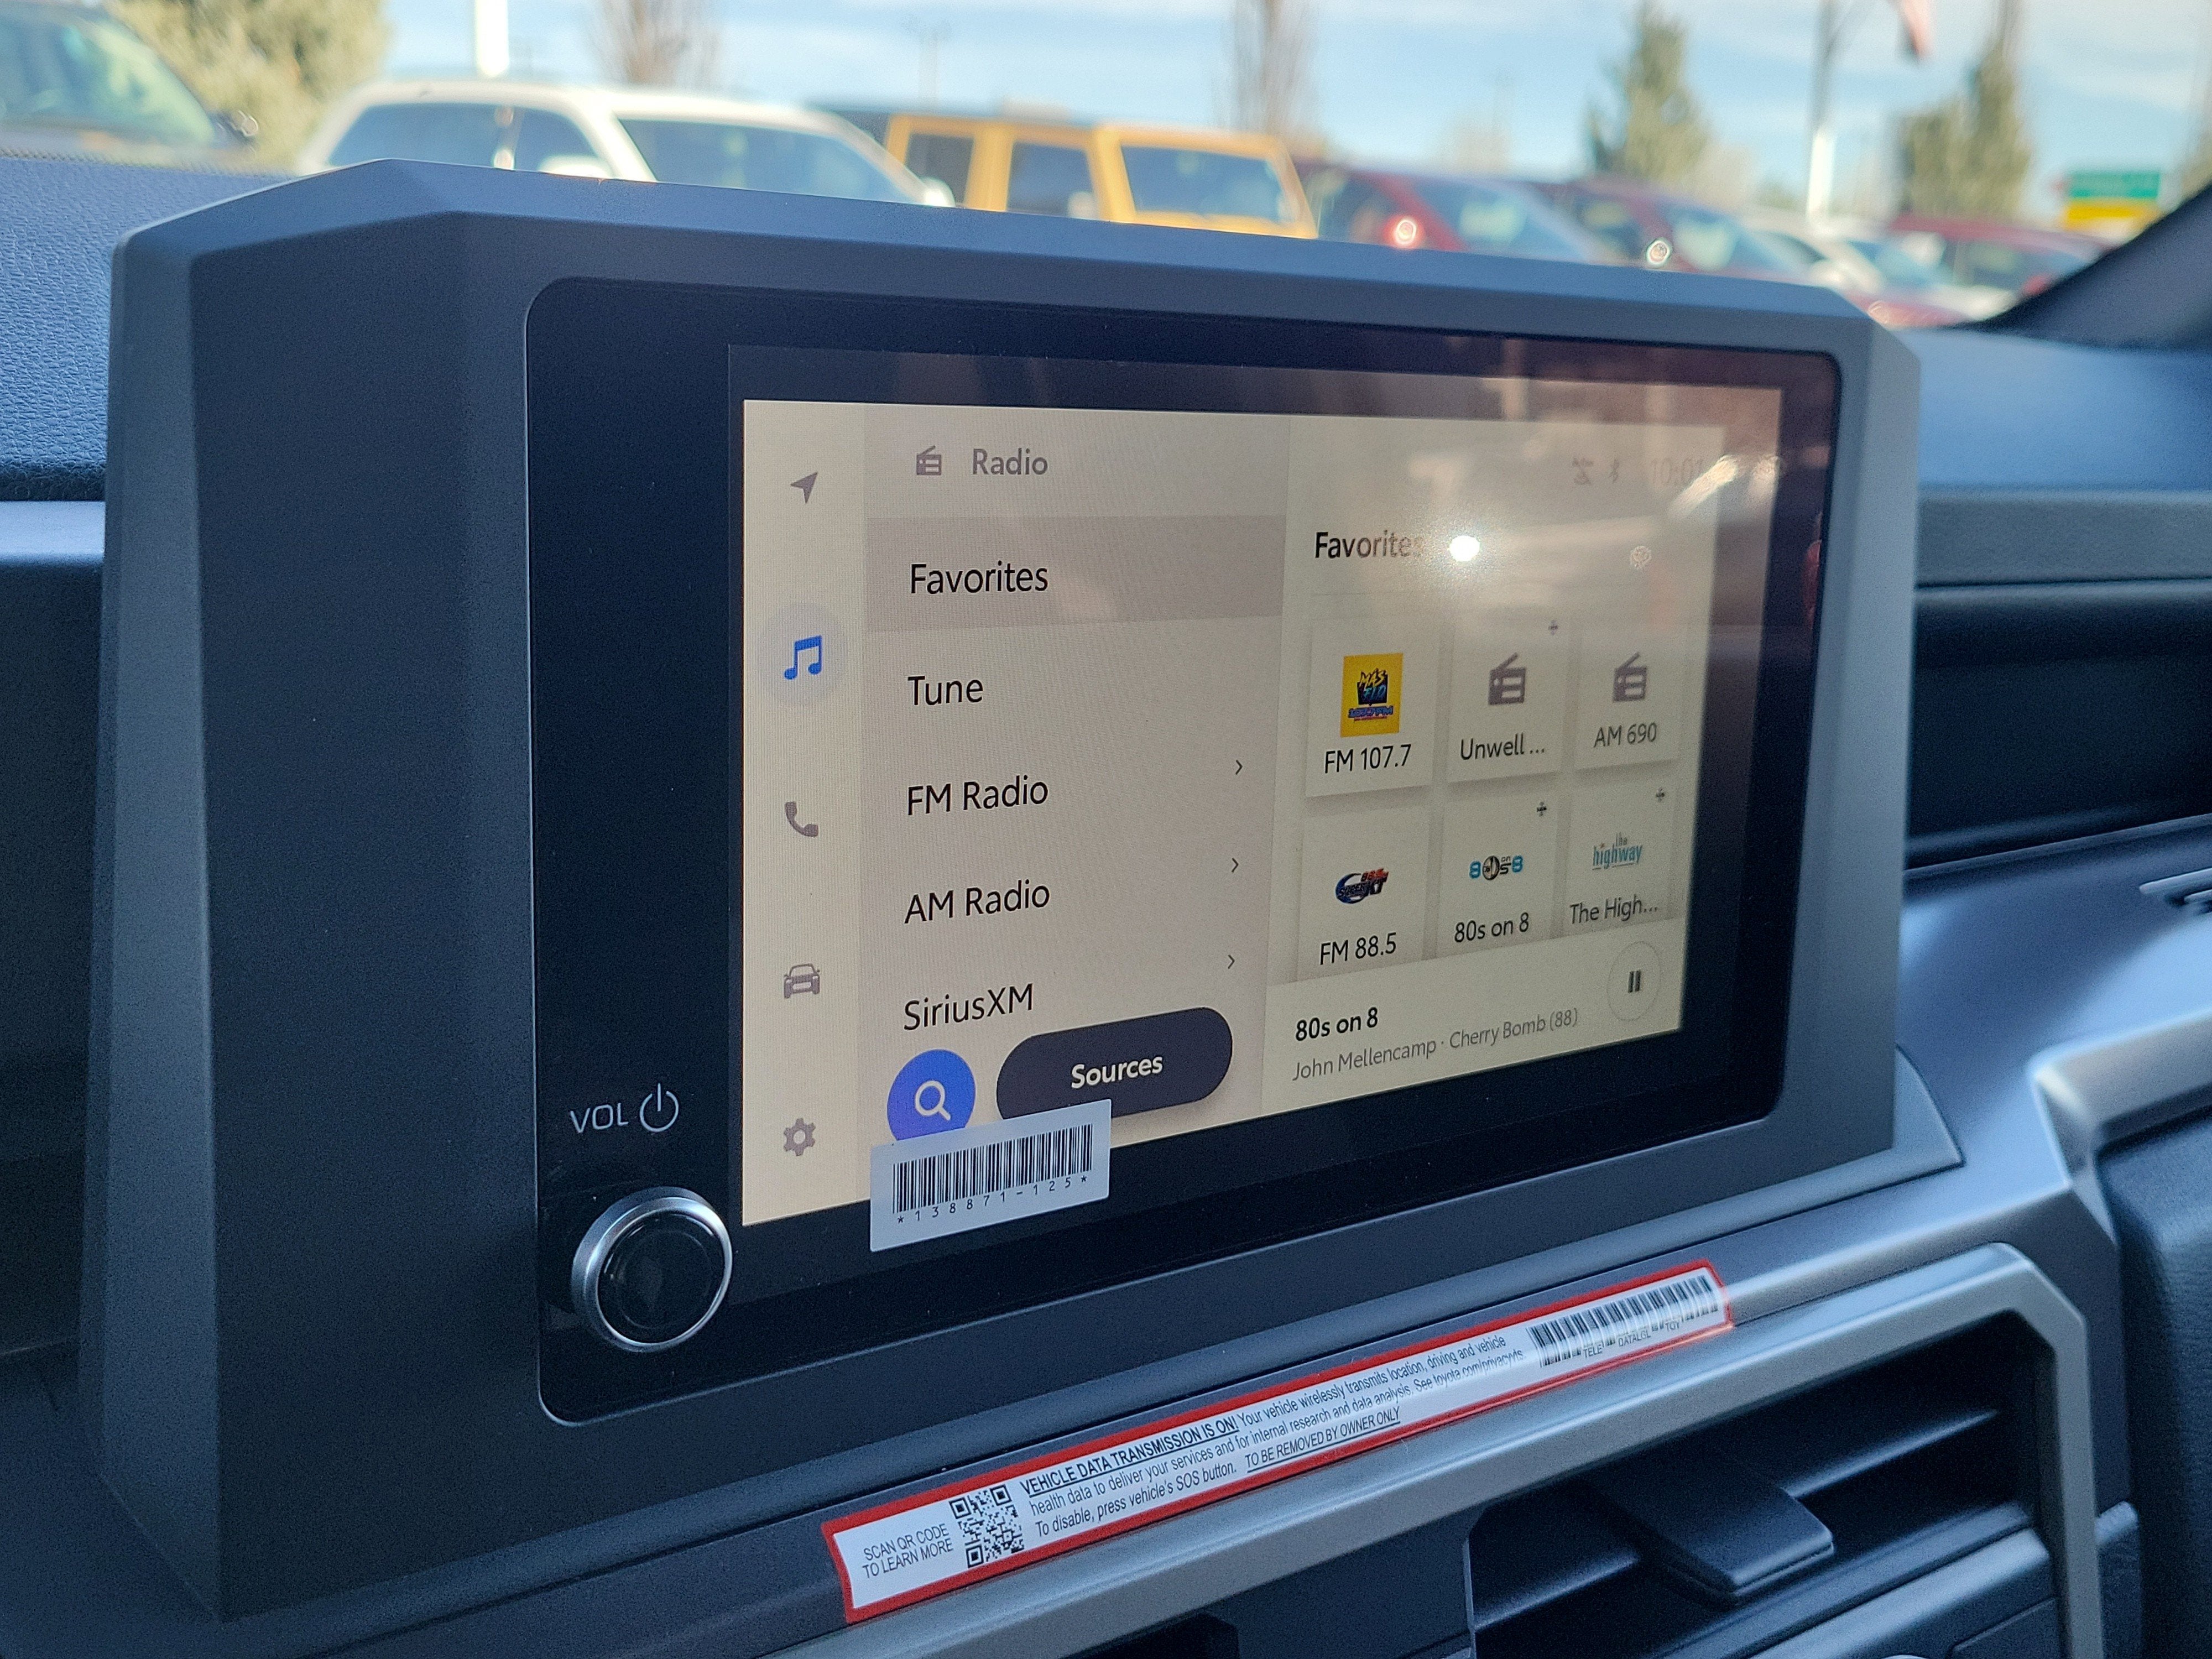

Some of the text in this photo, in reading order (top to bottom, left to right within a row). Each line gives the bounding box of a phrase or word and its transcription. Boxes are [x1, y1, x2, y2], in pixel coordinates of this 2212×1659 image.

[972, 448, 1049, 476] Radio
[910, 561, 1048, 594] Favorites
[907, 676, 984, 706] Tune
[1593, 722, 1657, 748] AM 690
[1324, 744, 1412, 774] FM 107.7
[908, 775, 1048, 816] FM Radio
[1592, 843, 1643, 869] highway
[904, 879, 1050, 924] AM Radio
[1570, 902, 1599, 925] The
[1454, 912, 1530, 943] 80s on 8
[1319, 932, 1396, 966] FM 88.5
[904, 983, 1034, 1031] SiriusXM
[1296, 1007, 1379, 1041] 80s on 8
[1292, 1059, 1333, 1081] John
[1338, 1039, 1436, 1073] Mellencamp
[1450, 1025, 1500, 1049] Cherry
[1503, 1016, 1546, 1039] Bomb
[1550, 1008, 1578, 1032] (88)
[1071, 1056, 1163, 1089] Sources
[570, 1103, 629, 1133] VOL
[1020, 1335, 1506, 1494] VEHICLE DATA TRANSMISSION IS ON! Your vehicle wirelessly transmits location, driving and vehicle
[1029, 1494, 1066, 1515] health
[1068, 1482, 1093, 1504] data
[1093, 1480, 1106, 1494] to
[1108, 1470, 1145, 1492] deliver
[1145, 1459, 1168, 1483] your
[1171, 1446, 1213, 1470] services
[1215, 1438, 1235, 1456] and
[1235, 1434, 1250, 1449] for
[1252, 1422, 1288, 1441] internal
[1289, 1409, 1332, 1430] research
[1333, 1404, 1350, 1418] and
[1352, 1396, 1373, 1411] data
[1375, 1384, 1413, 1405] analysis.
[1413, 1377, 1432, 1391] See
[1035, 1406, 1400, 1537] To disable, press vehicle's SOS button. TO BE REMOVED BY OWNER ONLY
[863, 1524, 950, 1561] SCAN QR CODE
[863, 1538, 953, 1579] TO LEARN MORE
